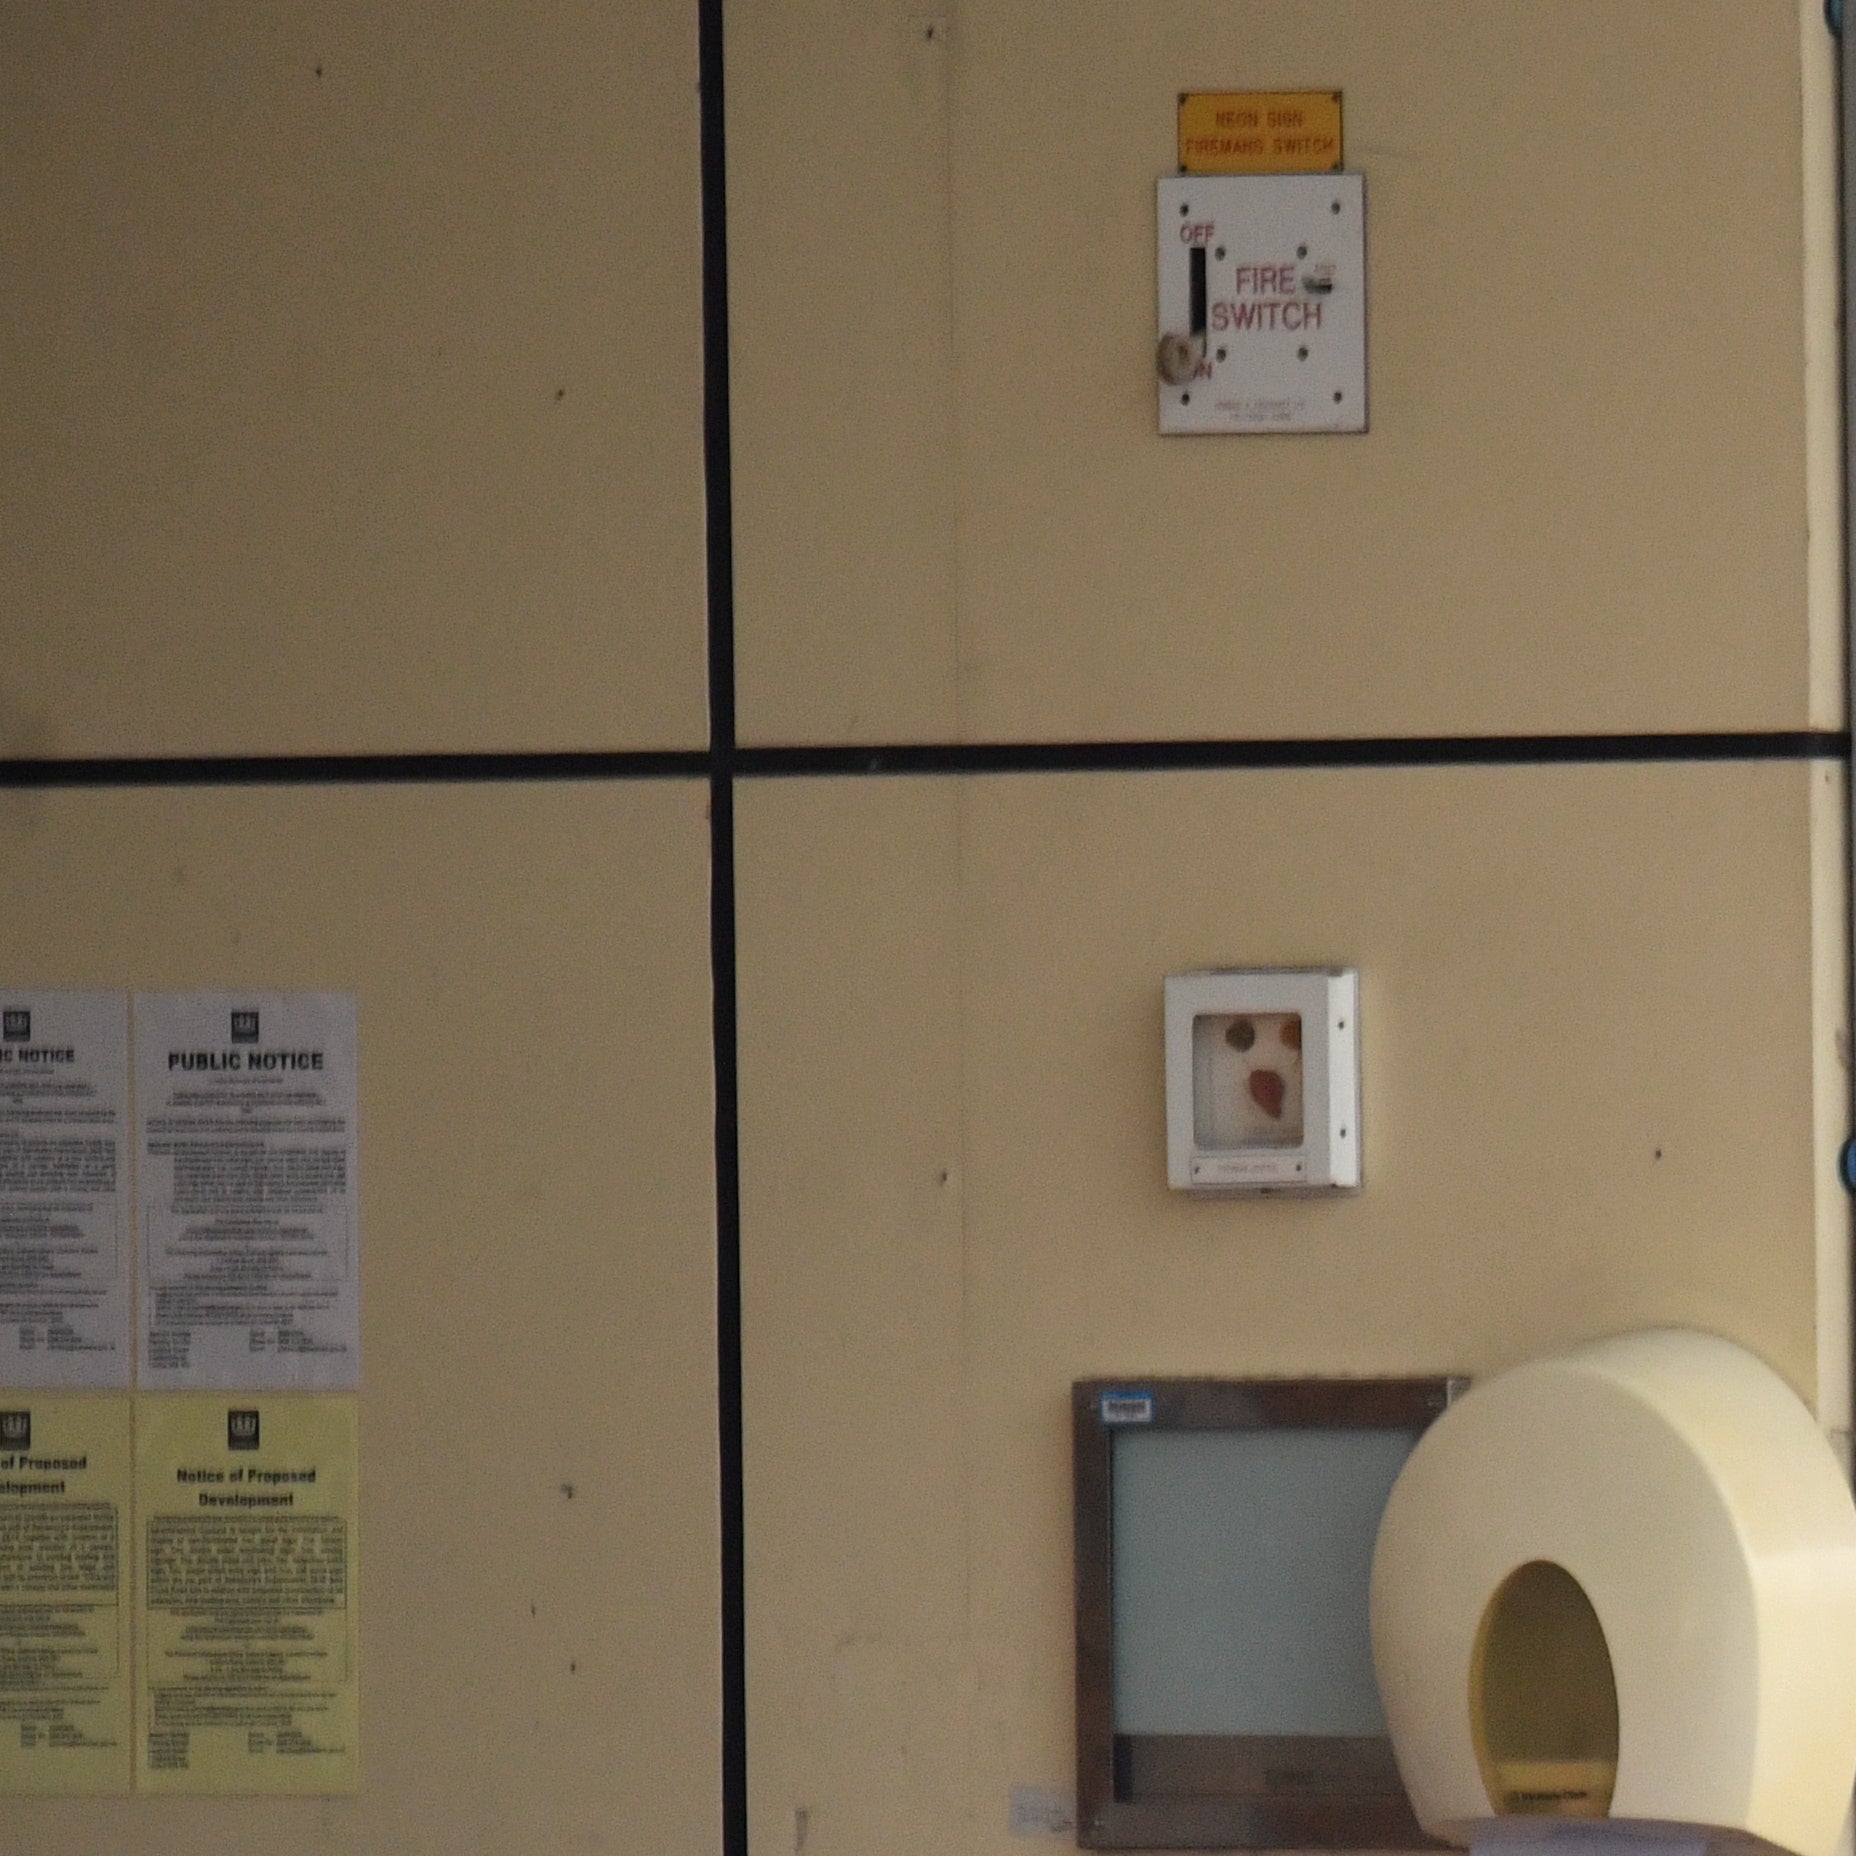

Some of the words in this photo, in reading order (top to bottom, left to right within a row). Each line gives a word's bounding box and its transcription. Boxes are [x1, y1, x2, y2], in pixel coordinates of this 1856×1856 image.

[1180, 224, 1214, 243] OFF
[1235, 266, 1296, 295] FIRE
[1211, 302, 1322, 332] SWITCH
[18, 1048, 75, 1063] NOTICE
[168, 1052, 241, 1071] PUBLIC
[248, 1052, 324, 1070] NOTICE
[19, 1456, 87, 1473] Proposed
[177, 1469, 224, 1484] Notice
[230, 1467, 244, 1484] of
[248, 1468, 316, 1487] Proposed
[199, 1494, 294, 1510] Development
